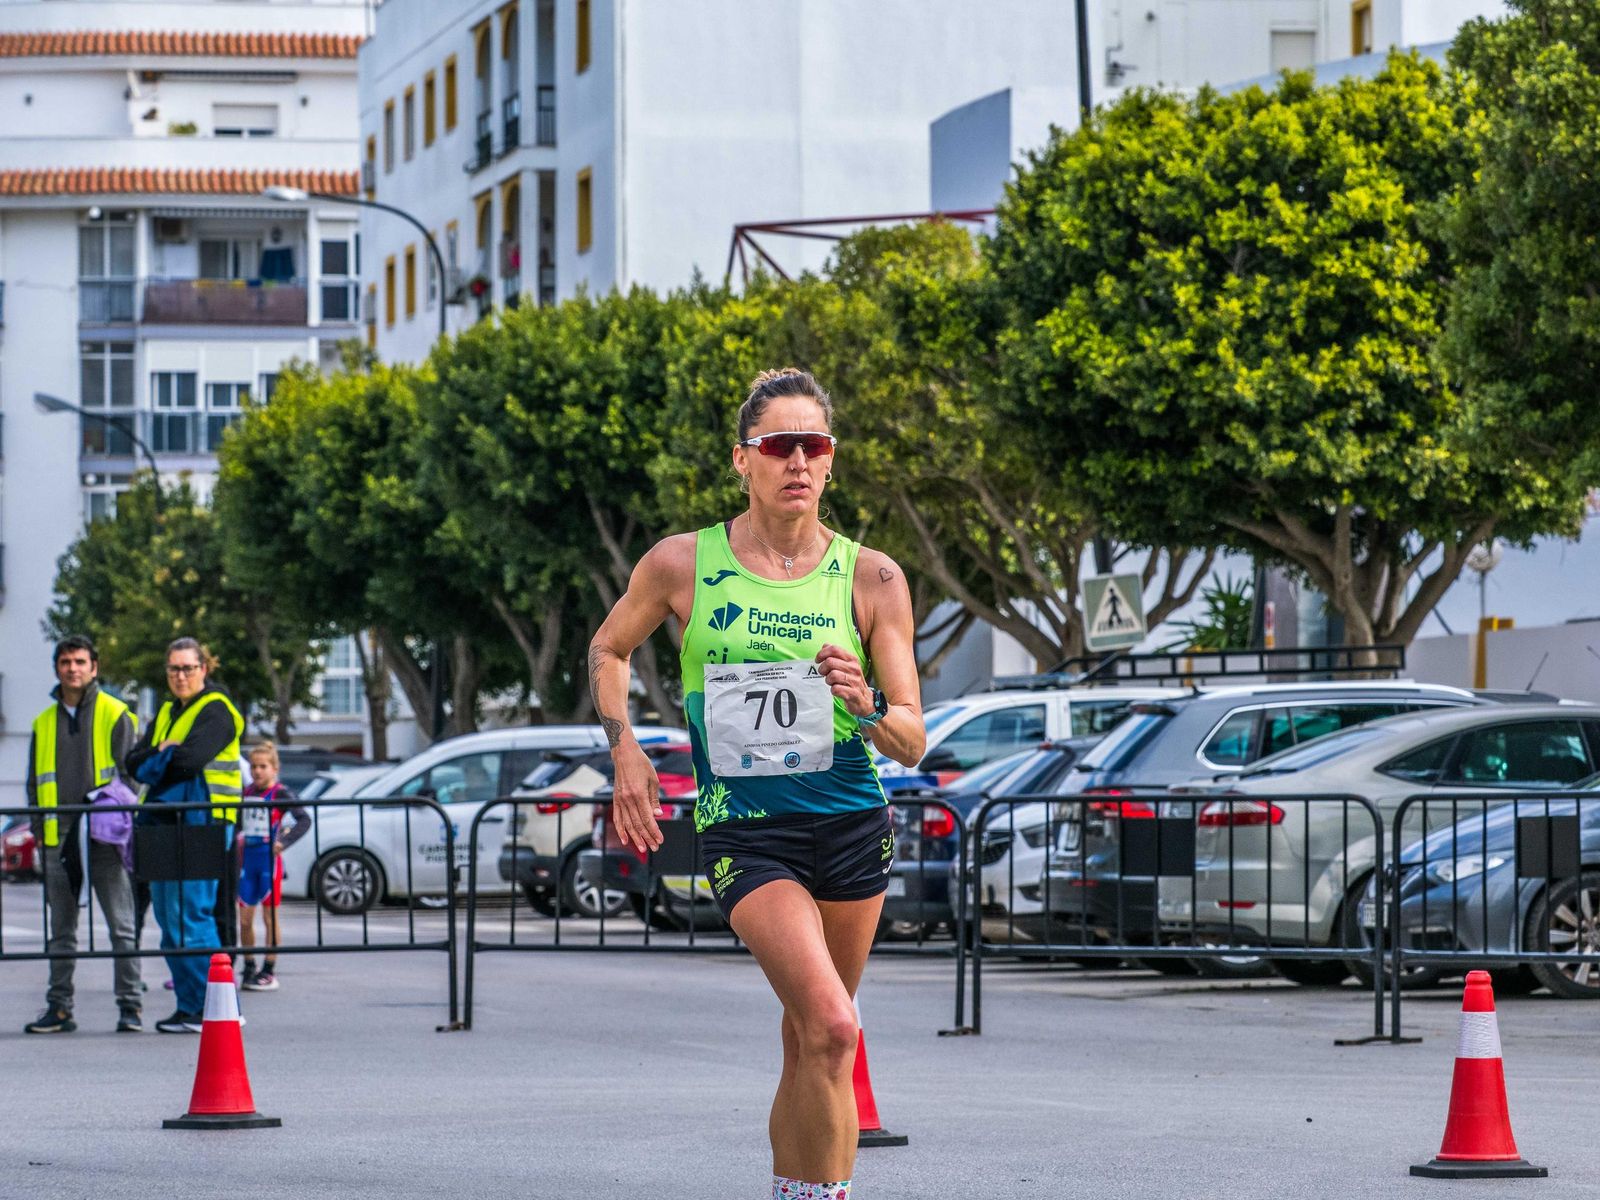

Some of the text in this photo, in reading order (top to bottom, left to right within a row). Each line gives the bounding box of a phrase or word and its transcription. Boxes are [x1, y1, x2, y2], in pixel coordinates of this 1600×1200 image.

[748, 607, 836, 628] Fundación
[747, 620, 812, 642] Unicaja
[746, 639, 775, 651] Jaén
[744, 688, 798, 730] 70
